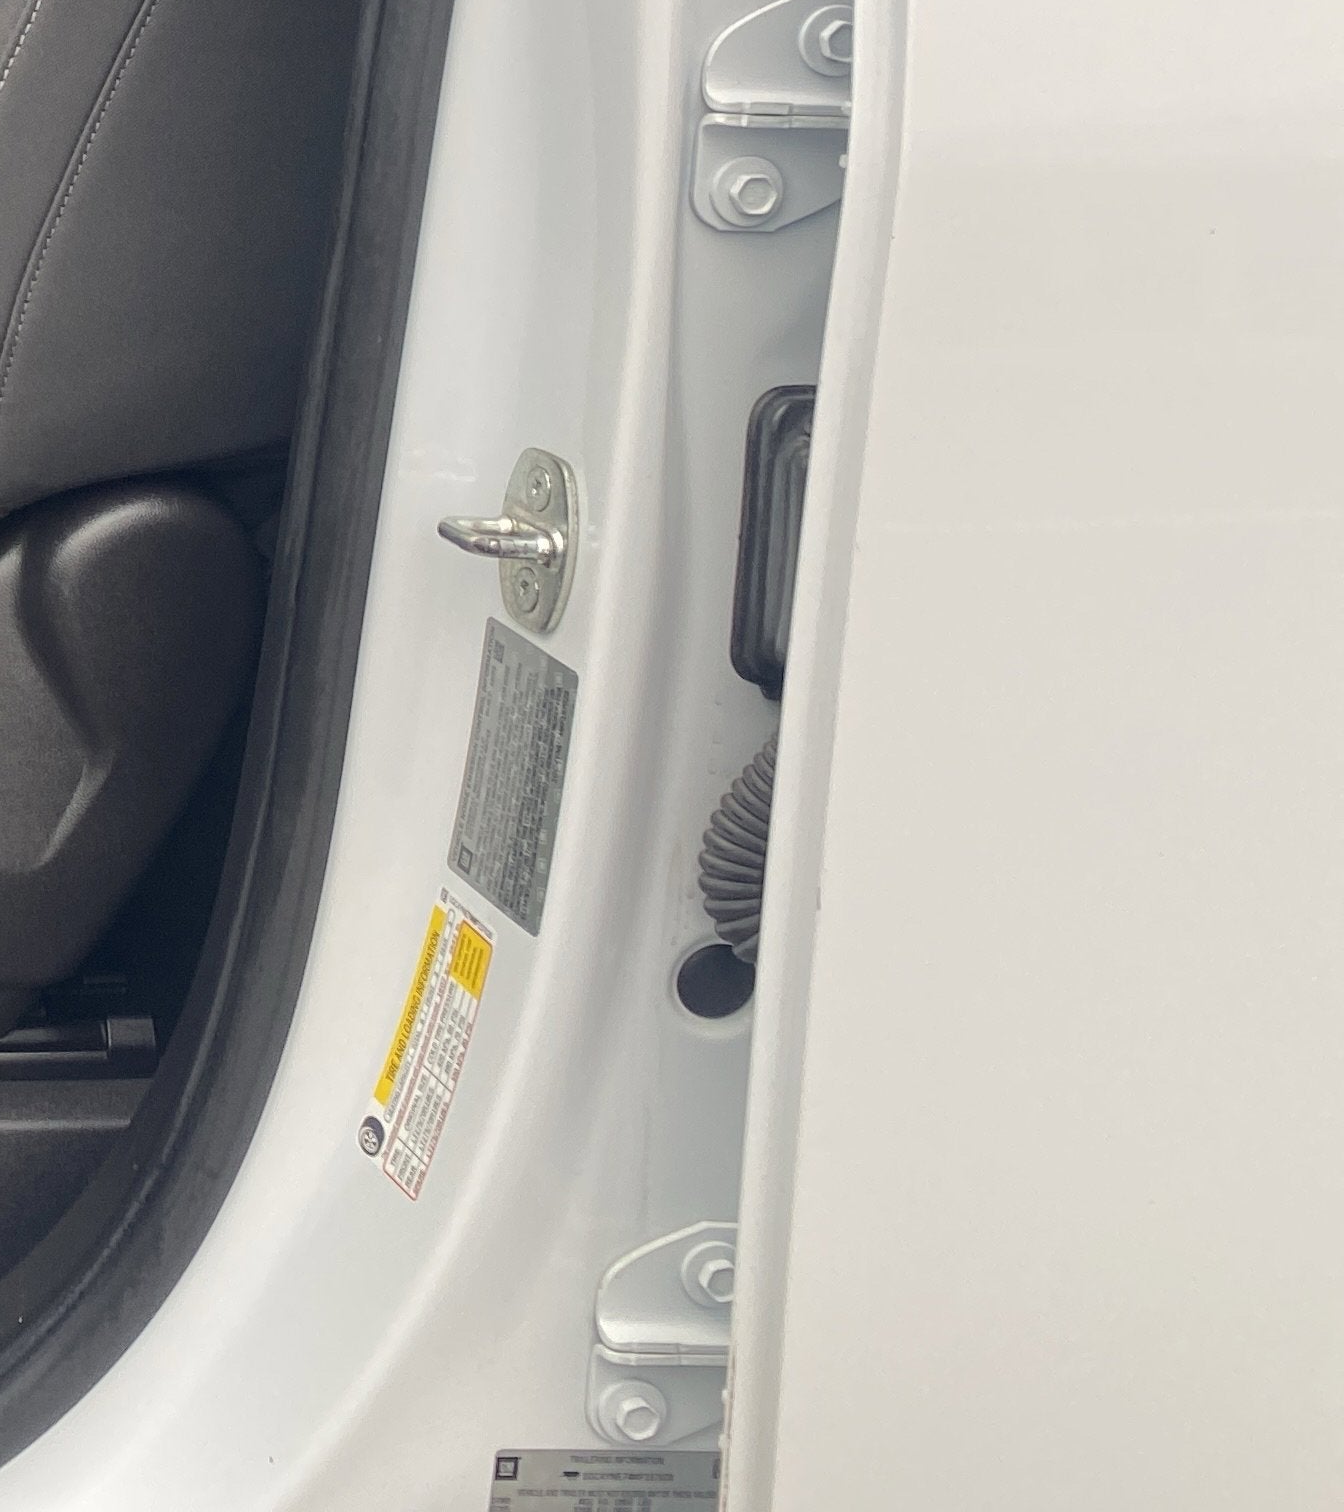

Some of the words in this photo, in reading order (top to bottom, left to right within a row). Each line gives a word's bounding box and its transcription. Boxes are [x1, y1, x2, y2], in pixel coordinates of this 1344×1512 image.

[385, 1058, 398, 1084] TIRE
[393, 1036, 408, 1063] AND
[401, 994, 421, 1038] LOADING
[415, 929, 441, 997] INFORMATION
